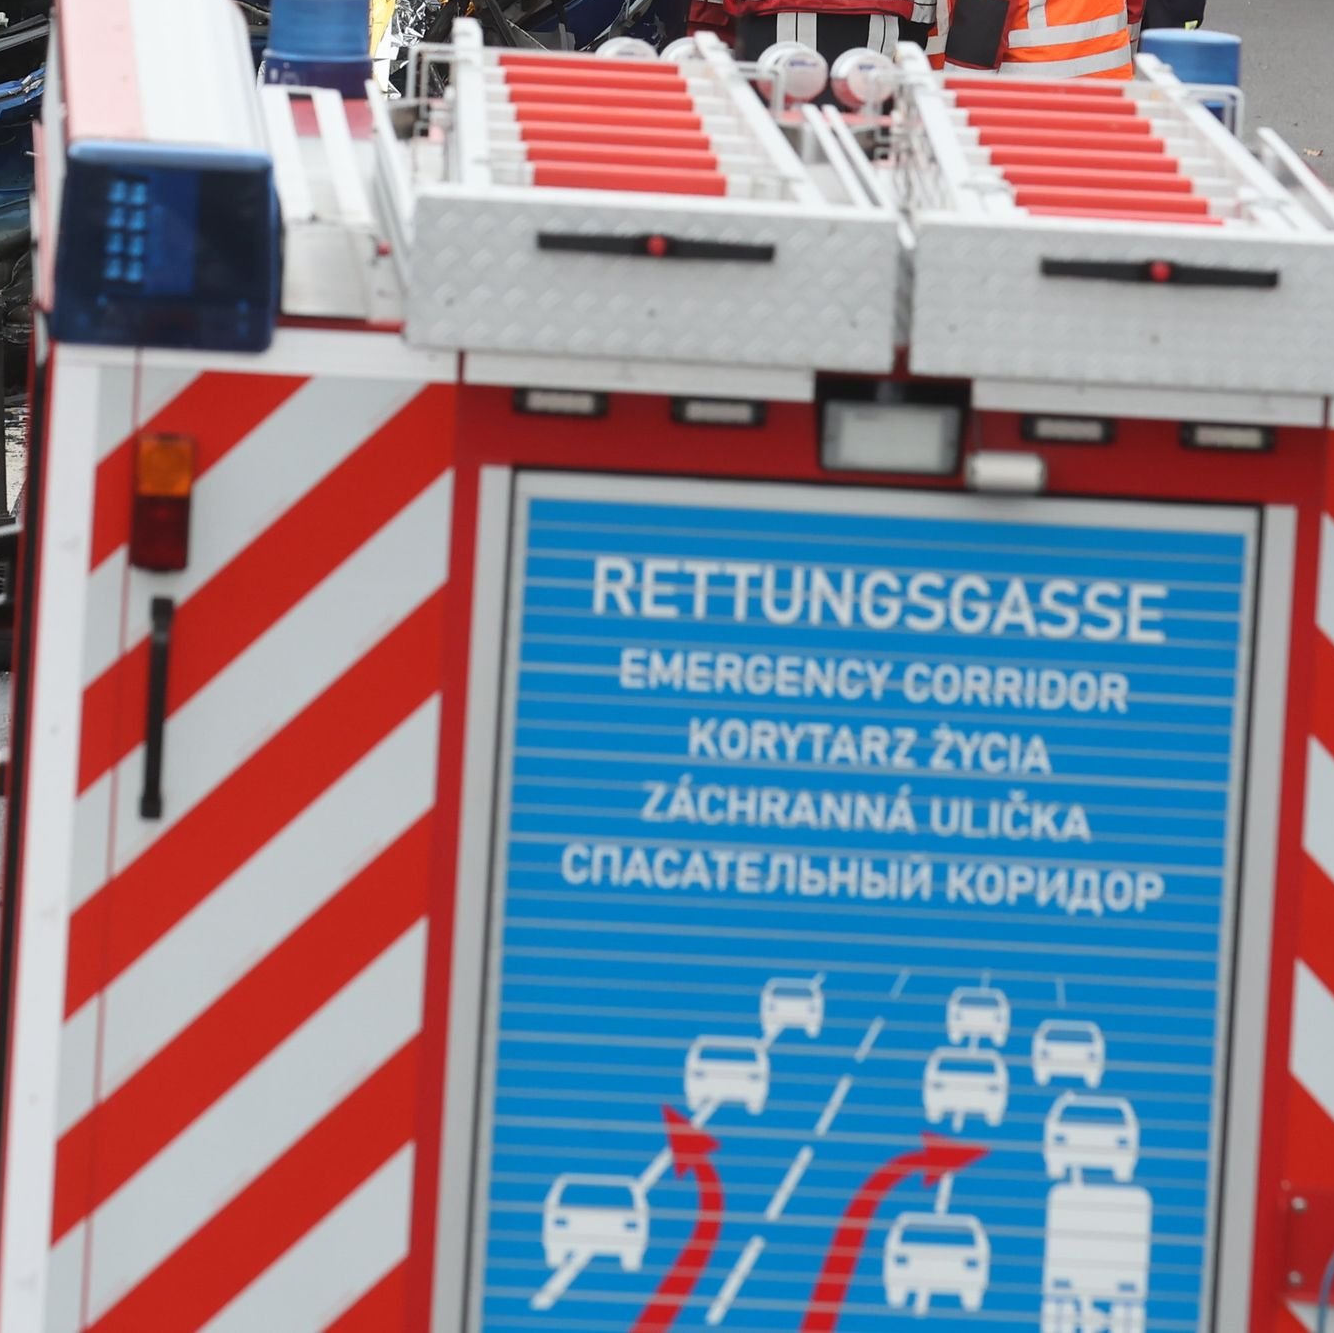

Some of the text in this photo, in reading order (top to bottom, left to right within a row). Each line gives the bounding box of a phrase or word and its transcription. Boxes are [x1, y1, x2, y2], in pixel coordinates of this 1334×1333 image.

[593, 555, 1169, 644] RETTUNGSGASSE
[619, 648, 1129, 714] EMERGENCY CORRIDOR
[688, 718, 1052, 775] KORYTARZ ŻYCIA
[640, 774, 1091, 843] ZÁCHRANNÁ ULIČKA
[561, 843, 1165, 917] СПАСАТЕЛЬНЫЙ КОРИДОР
